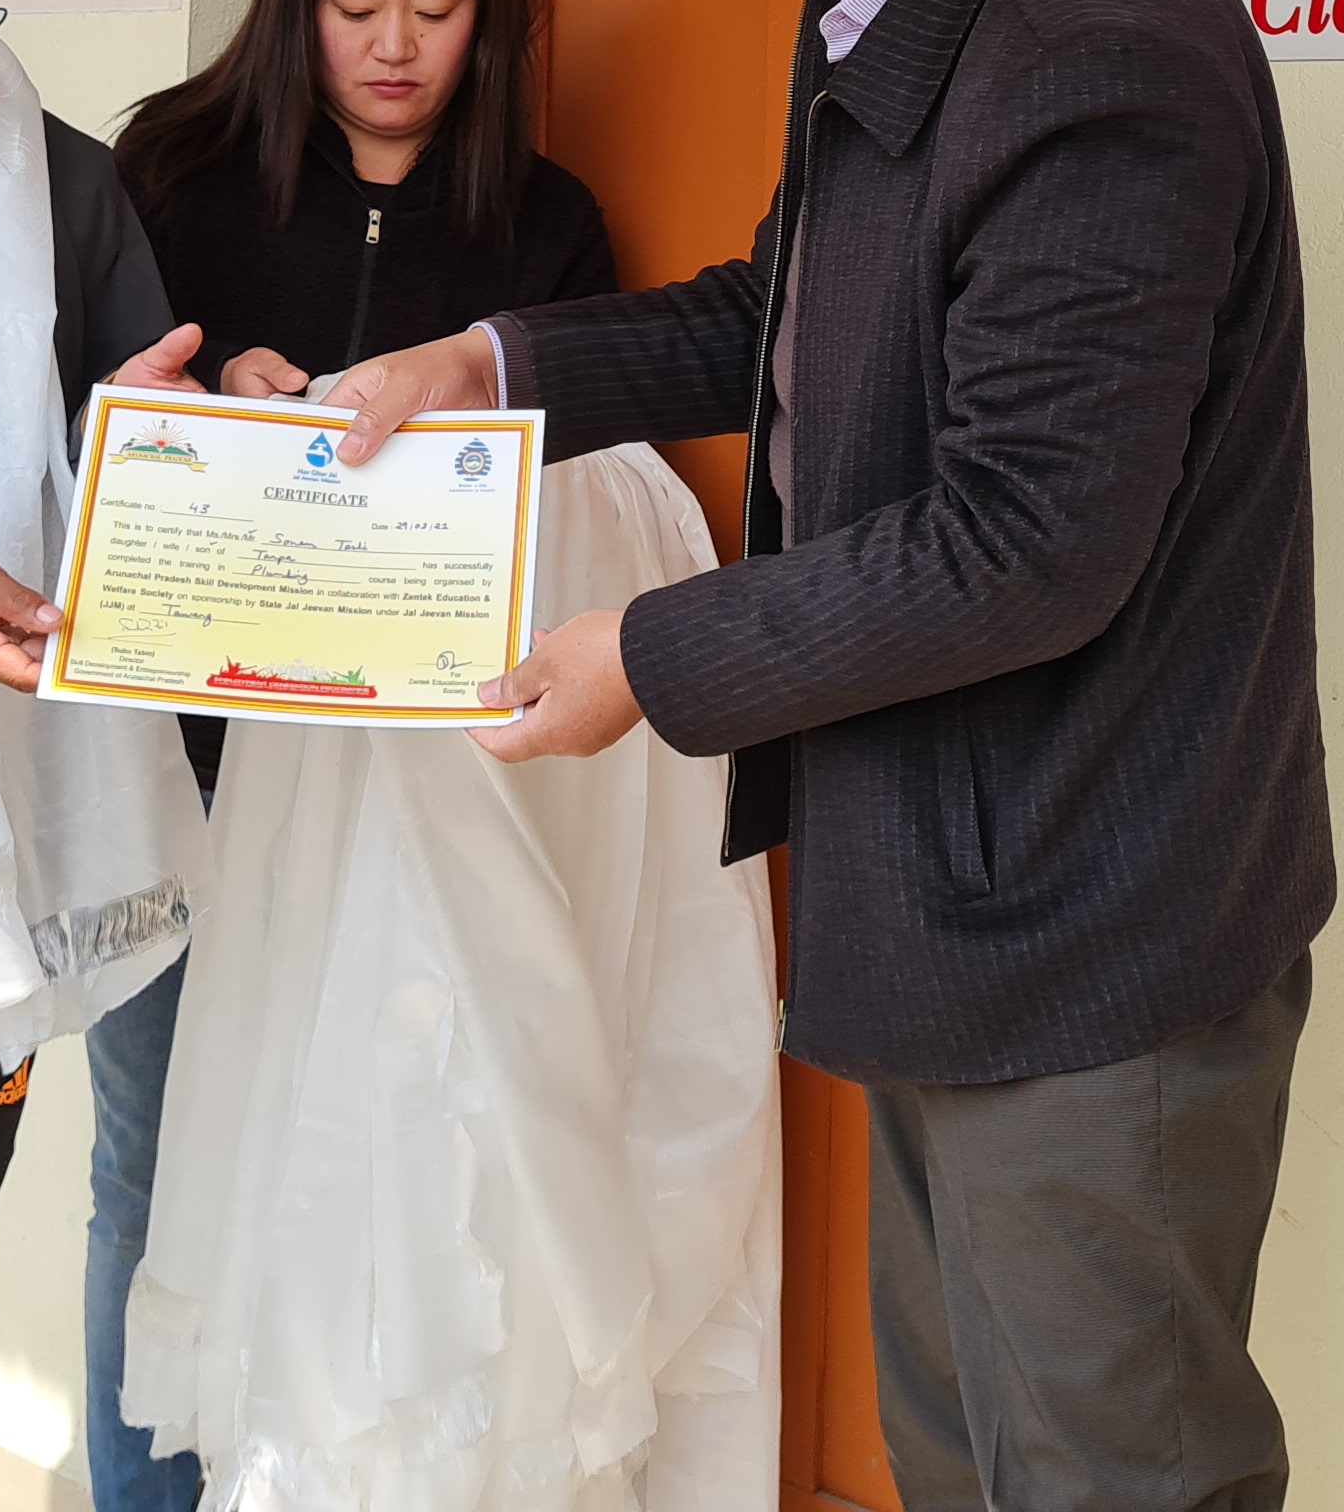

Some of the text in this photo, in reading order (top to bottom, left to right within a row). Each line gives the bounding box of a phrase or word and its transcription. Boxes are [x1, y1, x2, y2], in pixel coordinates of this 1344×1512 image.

[100, 498, 142, 509] Certificate
[263, 486, 368, 506] CERTIFICATE
[189, 502, 211, 514] 43
[113, 520, 131, 530] This
[146, 524, 153, 532] to
[158, 525, 183, 536] certify
[186, 528, 203, 537] that
[110, 537, 147, 548] daughter
[163, 542, 180, 551] wife
[195, 545, 211, 554] son
[217, 547, 226, 555] of
[107, 554, 151, 565] completed
[159, 558, 172, 566] the
[180, 560, 210, 571] training
[422, 562, 494, 571] has successfully
[105, 569, 491, 602] Arunachal Pradesh Skill Development Mission in collaboration with Zentek Education &
[368, 576, 493, 588] course being organised by
[99, 600, 135, 611] (JJM) at
[102, 583, 137, 595] Welfare
[140, 587, 174, 600] Society
[191, 594, 243, 606] sponsorship
[246, 598, 256, 607] by
[259, 599, 282, 609] State
[285, 601, 299, 611] Jal
[302, 603, 334, 613] Jeevan
[337, 605, 373, 615] Mission
[376, 607, 400, 616] under
[403, 608, 416, 617] Jal
[419, 609, 451, 618] Jeevan
[454, 610, 489, 619] Mission
